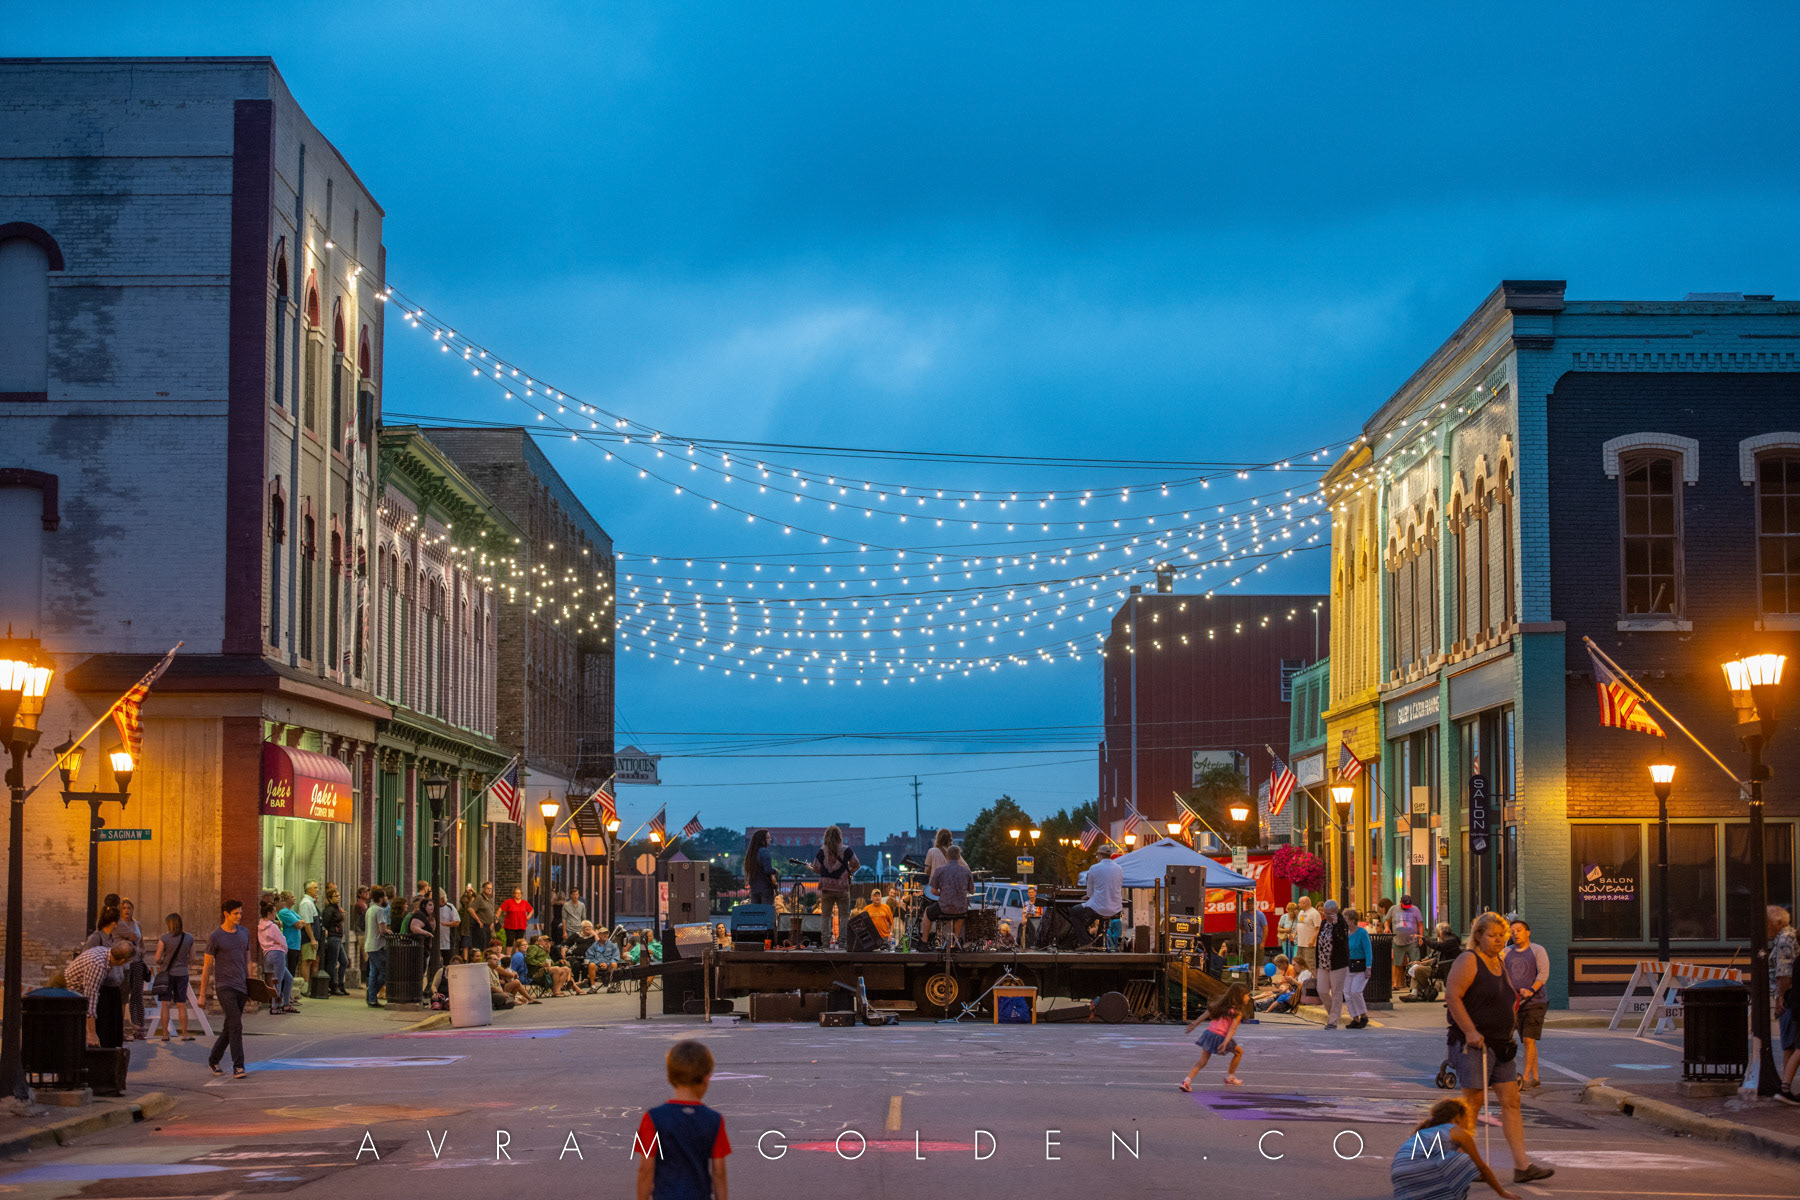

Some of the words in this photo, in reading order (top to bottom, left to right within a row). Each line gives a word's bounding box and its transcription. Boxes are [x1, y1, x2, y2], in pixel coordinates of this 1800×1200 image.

[265, 778, 292, 805] Jake's
[309, 783, 338, 816] Jake's
[270, 799, 286, 808] BAR
[1473, 778, 1486, 830] SALON
[108, 830, 143, 839] SAGINAW
[1665, 1007, 1685, 1017] BCT
